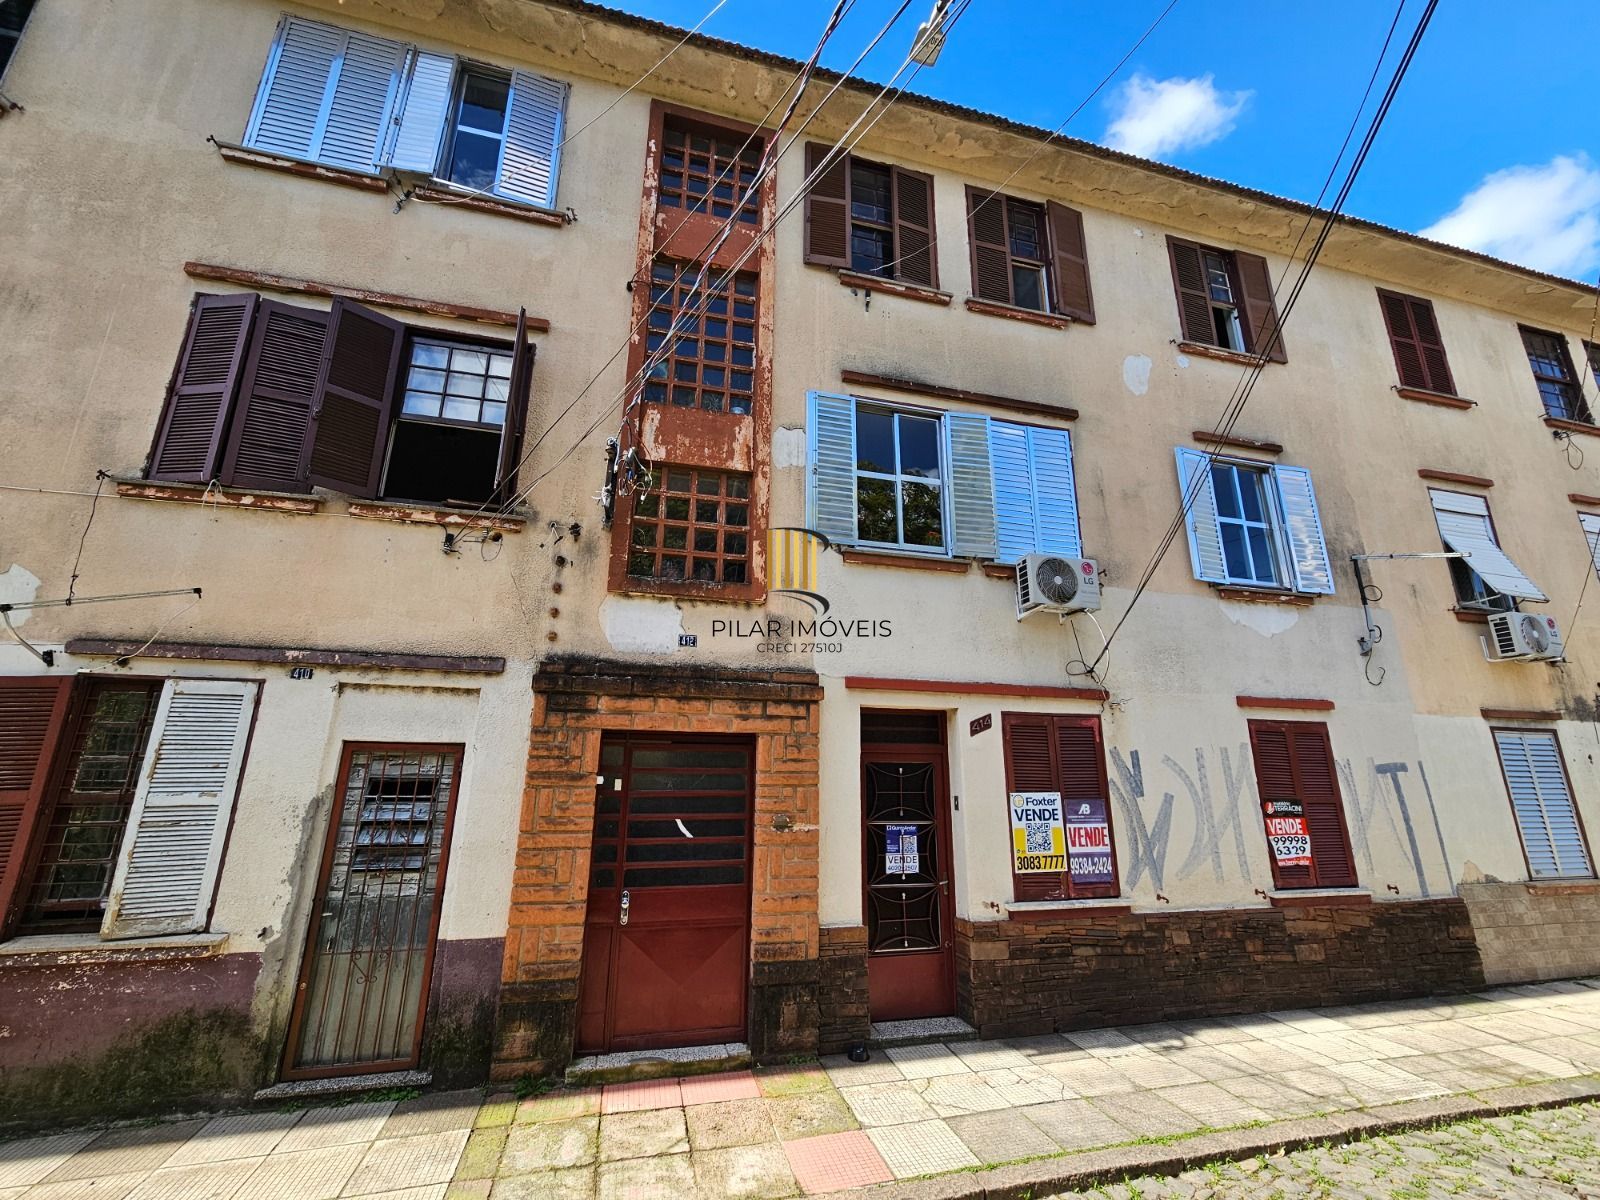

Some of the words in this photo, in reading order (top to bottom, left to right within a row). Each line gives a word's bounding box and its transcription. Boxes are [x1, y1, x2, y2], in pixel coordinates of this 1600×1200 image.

[1083, 577, 1094, 585] LG
[293, 668, 311, 680] 410
[972, 716, 990, 730] 414
[1025, 796, 1057, 806] Foxter
[1014, 808, 1059, 822] VENDE
[1267, 818, 1303, 835] VENDE
[1068, 826, 1109, 848] VENDE
[1273, 835, 1308, 846] 99998
[1276, 846, 1306, 856] 6329
[888, 855, 917, 864] VENDE
[1070, 857, 1112, 875] 99384-2424
